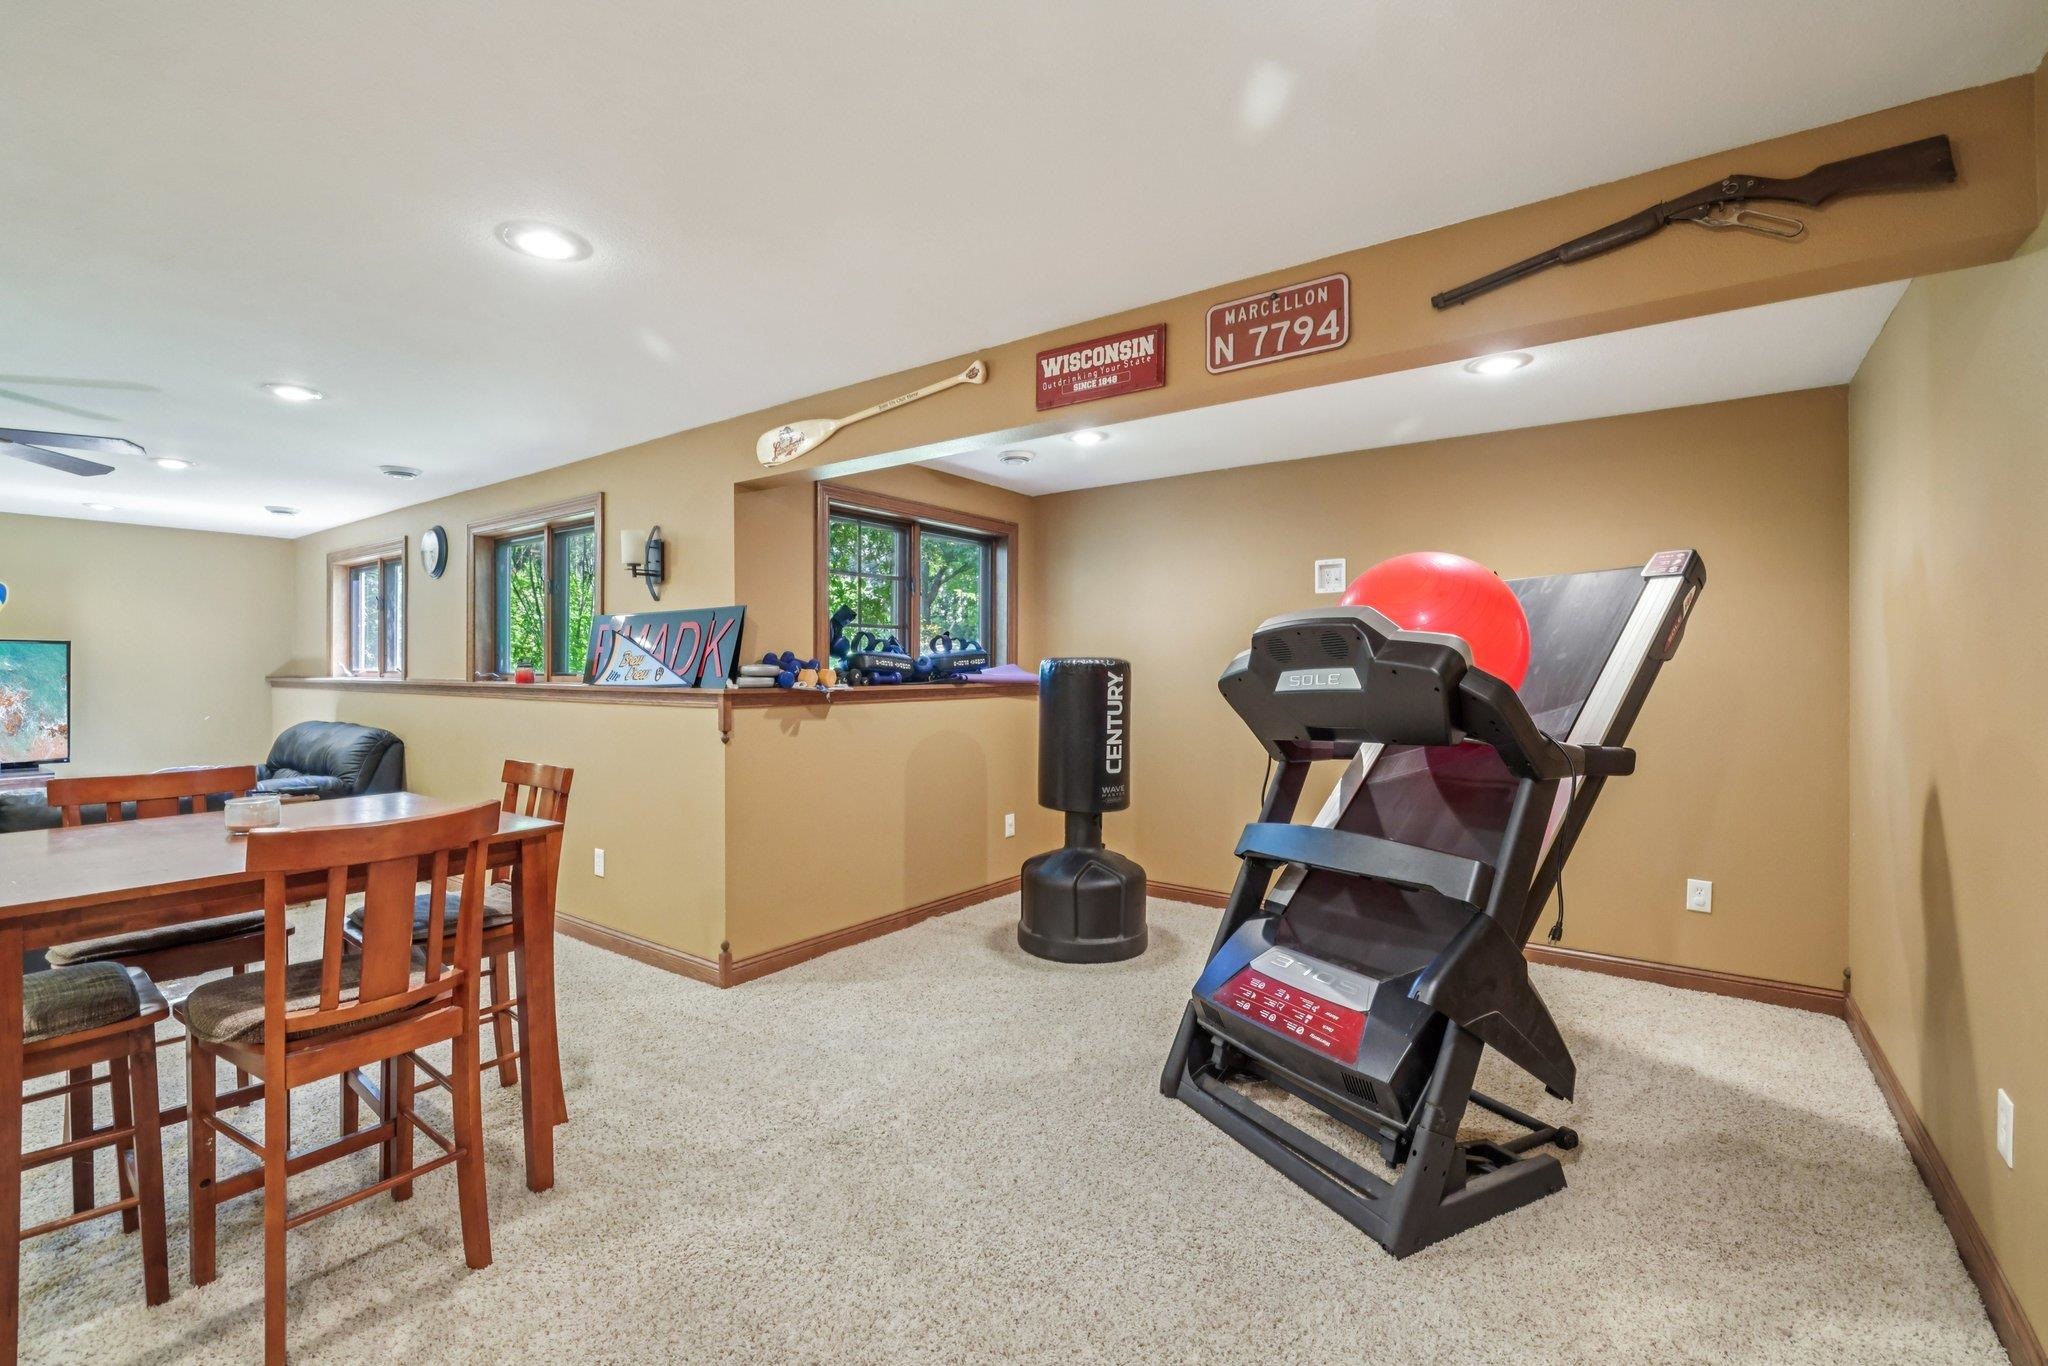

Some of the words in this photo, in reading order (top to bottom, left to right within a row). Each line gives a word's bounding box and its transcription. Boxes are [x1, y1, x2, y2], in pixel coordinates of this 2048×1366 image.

[1225, 286, 1329, 326] MARCELLON
[1215, 333, 1234, 365] N
[1248, 309, 1340, 357] 7794
[1041, 334, 1155, 378] WISCONSIN
[1042, 370, 1098, 391] Outdrinking
[1100, 363, 1121, 375] Your
[1123, 355, 1152, 369] State
[1073, 379, 1097, 392] SINCE
[1098, 375, 1118, 387] 1848
[619, 650, 645, 668] Brew
[605, 669, 621, 682] Lite
[1289, 673, 1341, 687] SOLE
[1101, 784, 1125, 794] WAVE
[1270, 954, 1362, 995] SOLE
[1309, 1032, 1331, 1048] Warranty
